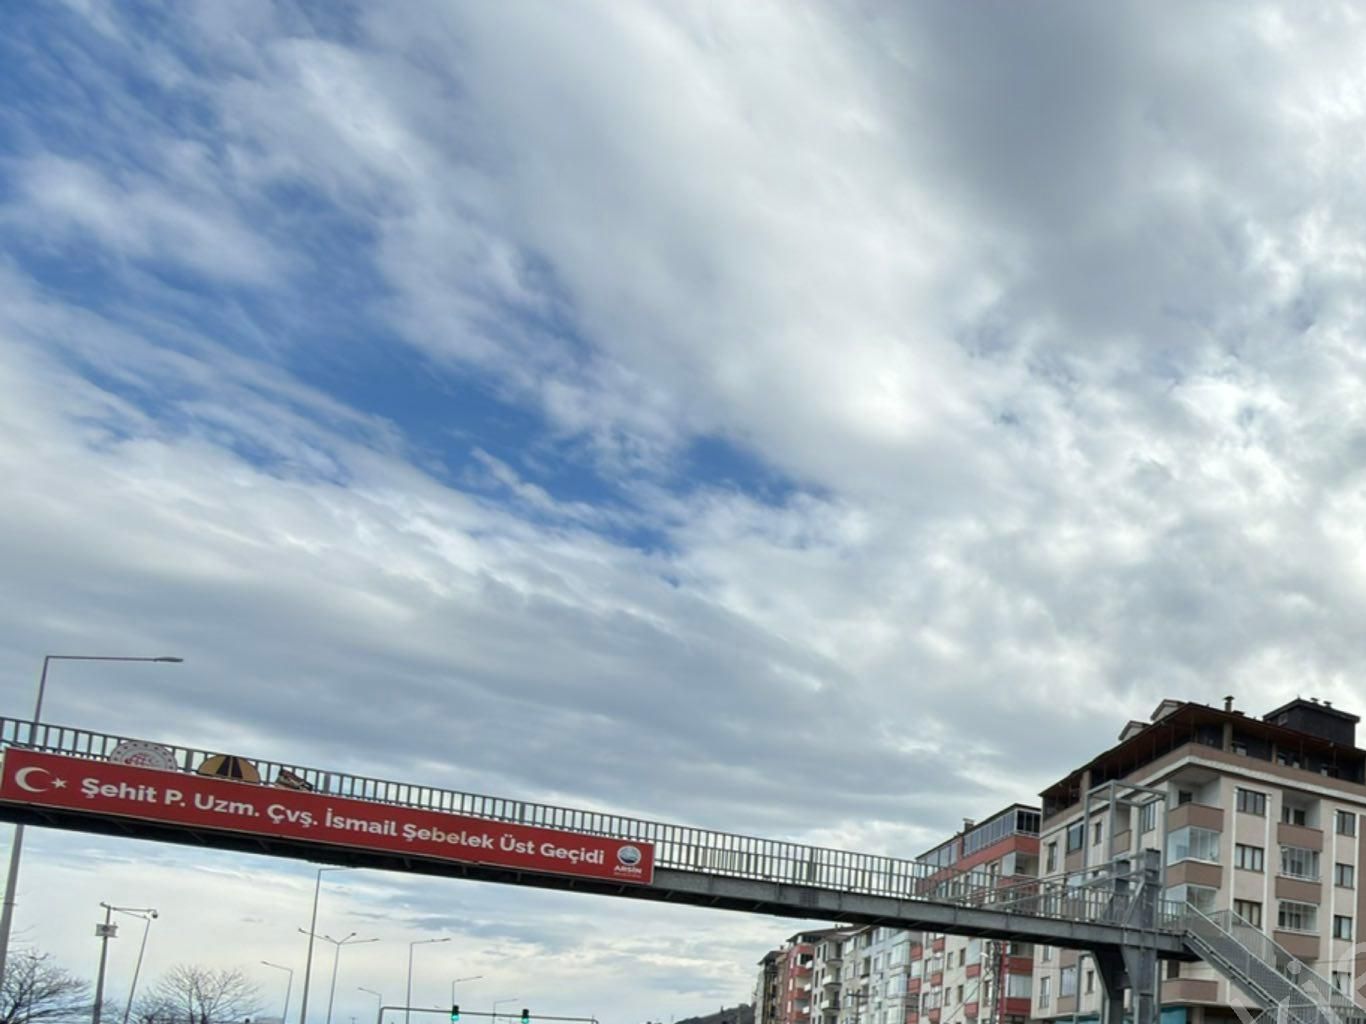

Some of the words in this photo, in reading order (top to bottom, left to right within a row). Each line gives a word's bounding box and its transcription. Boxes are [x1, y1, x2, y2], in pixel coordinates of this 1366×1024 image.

[81, 778, 157, 804] Şehit
[164, 790, 186, 807] P.
[194, 795, 260, 817] Uzm.
[267, 804, 318, 828] Çvş.
[325, 808, 398, 837] İsmail
[402, 824, 494, 849] Şebelek
[500, 833, 535, 855] Üst
[540, 843, 605, 865] Geçidi
